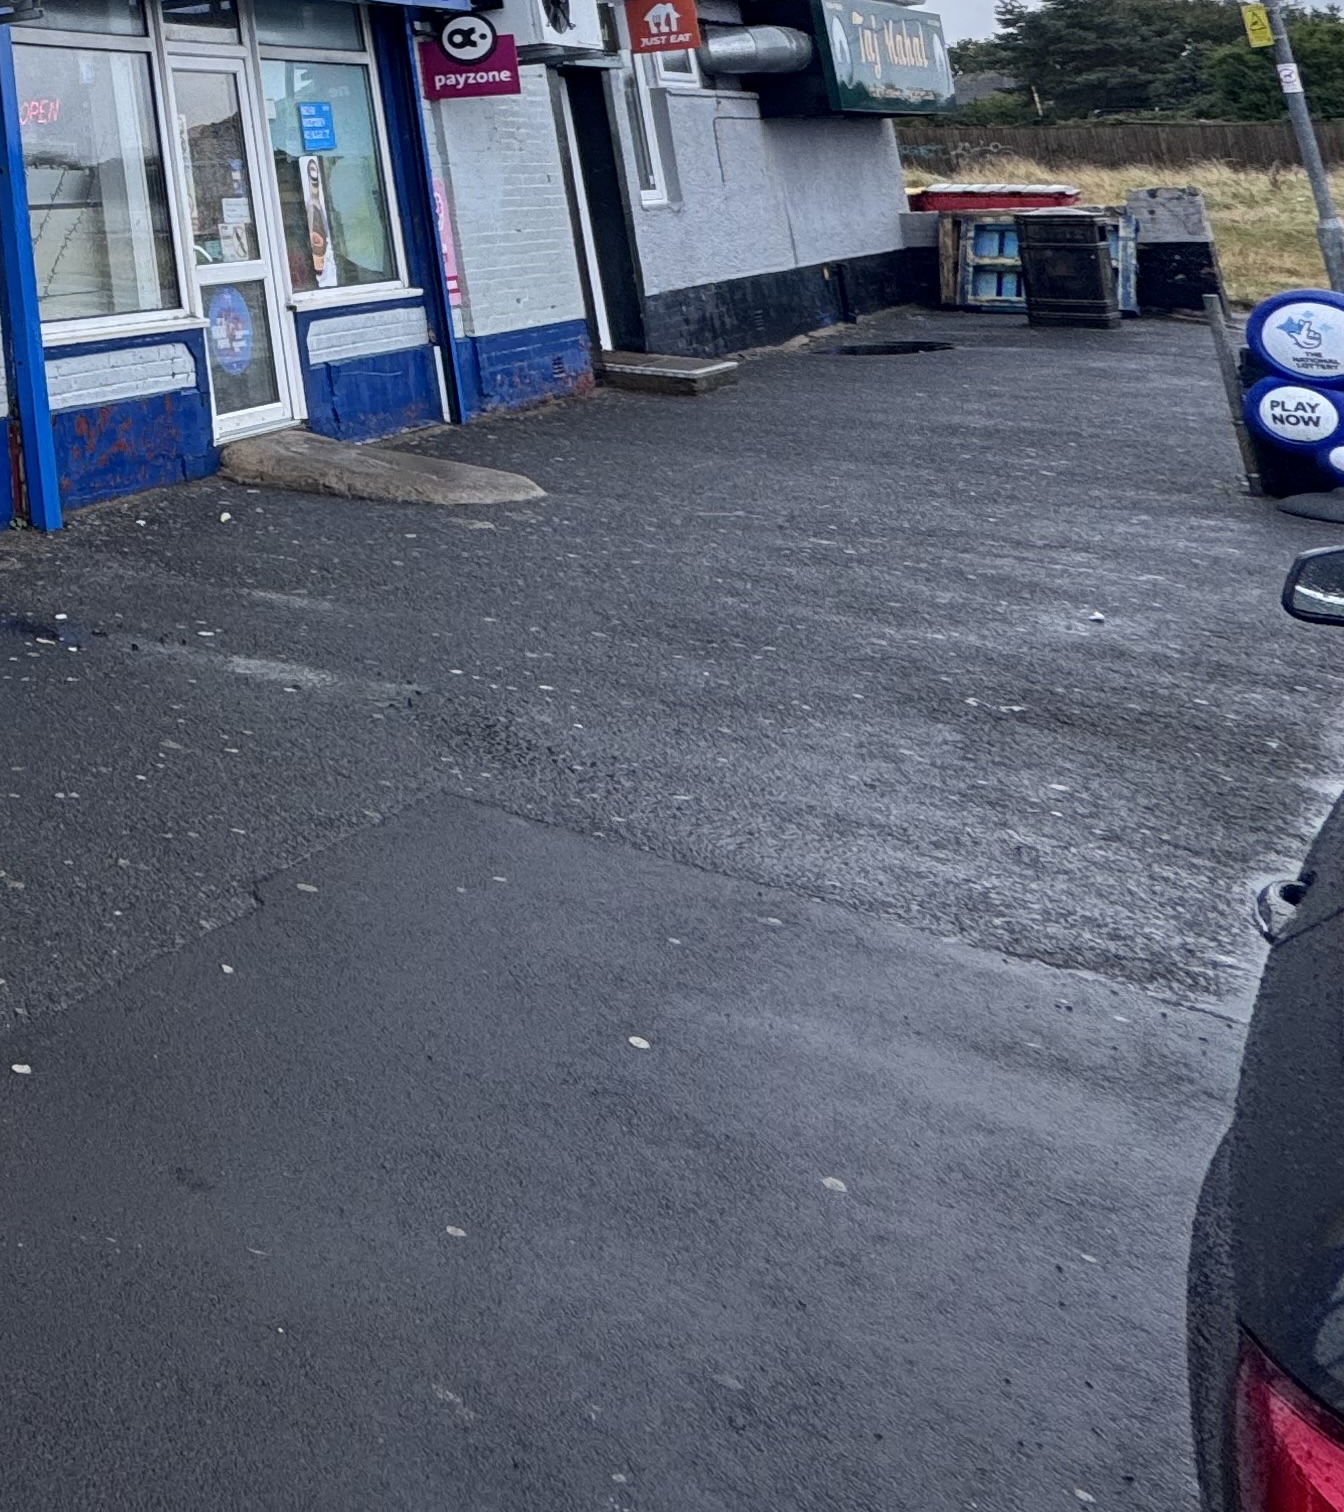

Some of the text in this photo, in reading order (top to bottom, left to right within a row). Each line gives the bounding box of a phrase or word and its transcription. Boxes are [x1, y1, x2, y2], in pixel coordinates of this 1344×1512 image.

[640, 33, 692, 47] JUST EAT
[434, 69, 512, 91] payzone
[19, 98, 61, 126] OPEN
[1269, 399, 1321, 414] PLAY
[1272, 413, 1322, 428] NOW
